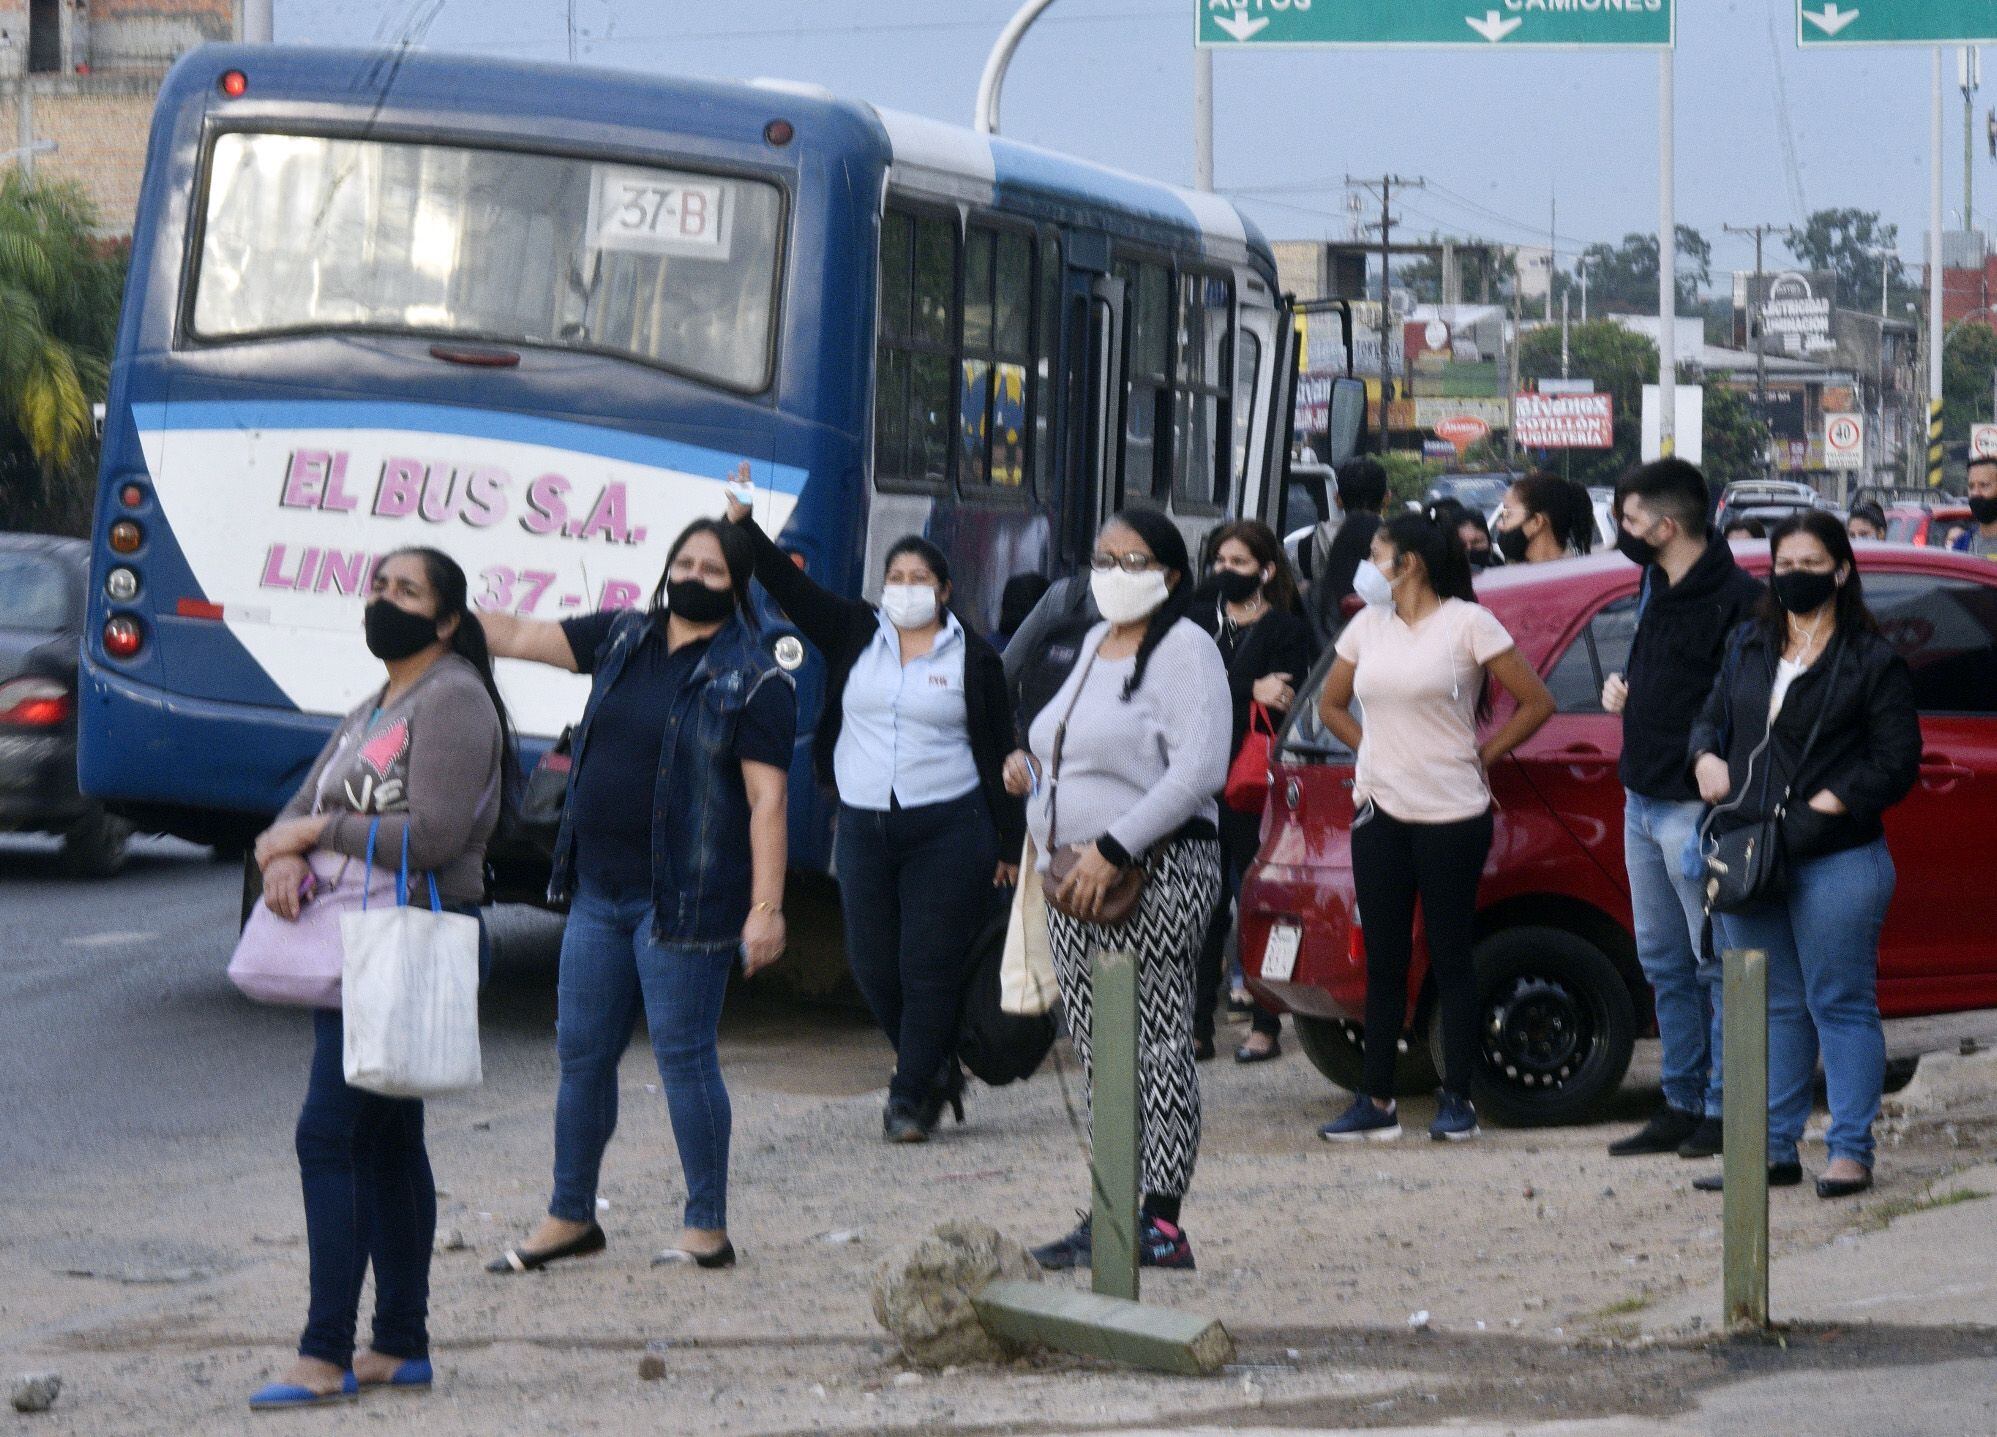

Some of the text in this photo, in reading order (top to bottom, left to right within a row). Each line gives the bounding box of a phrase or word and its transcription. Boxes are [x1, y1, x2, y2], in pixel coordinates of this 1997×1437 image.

[620, 184, 708, 237] 37-B
[1835, 423, 1851, 441] 40
[280, 448, 648, 545] EL BUS S.A.
